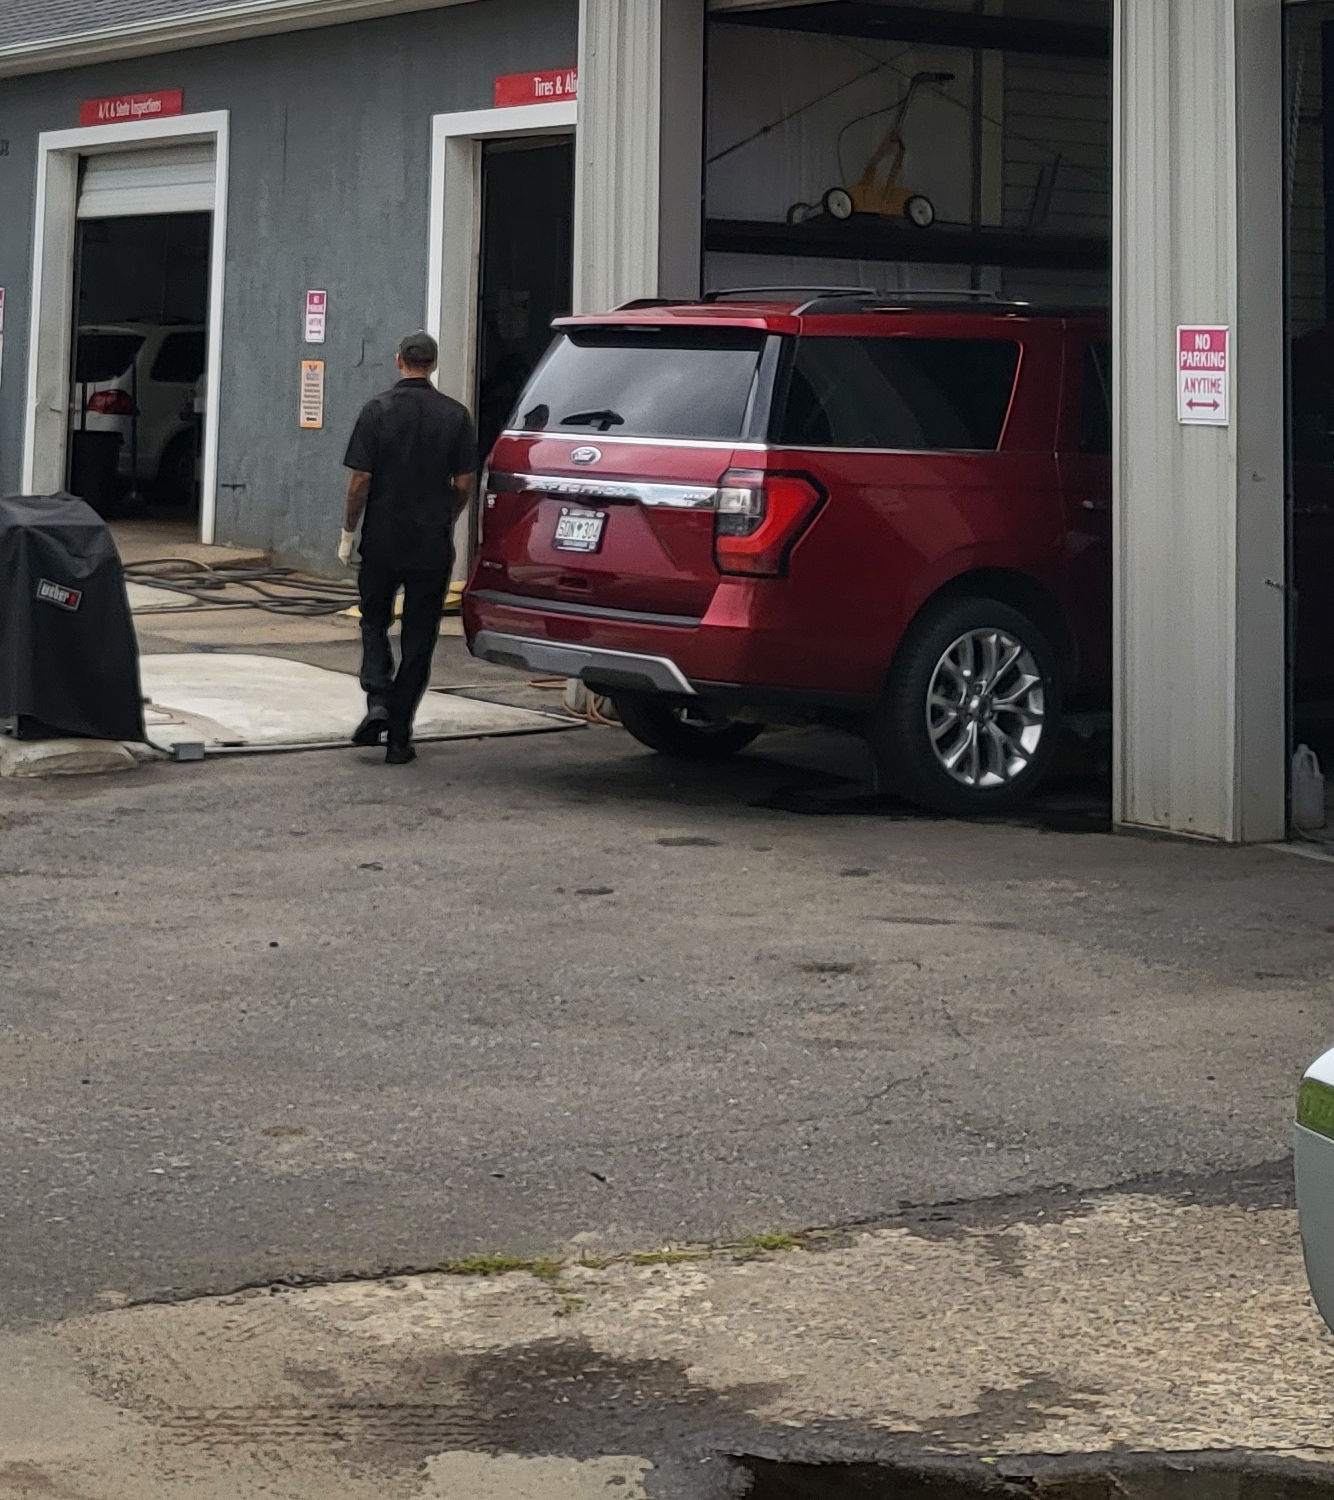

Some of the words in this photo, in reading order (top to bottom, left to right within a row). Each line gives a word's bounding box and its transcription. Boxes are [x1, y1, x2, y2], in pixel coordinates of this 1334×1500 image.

[533, 76, 554, 97] Tires
[555, 75, 563, 95] &
[565, 71, 578, 94] Ali
[1194, 333, 1211, 351] NO
[1180, 351, 1225, 368] PARKING
[1183, 377, 1223, 395] ANYTIME
